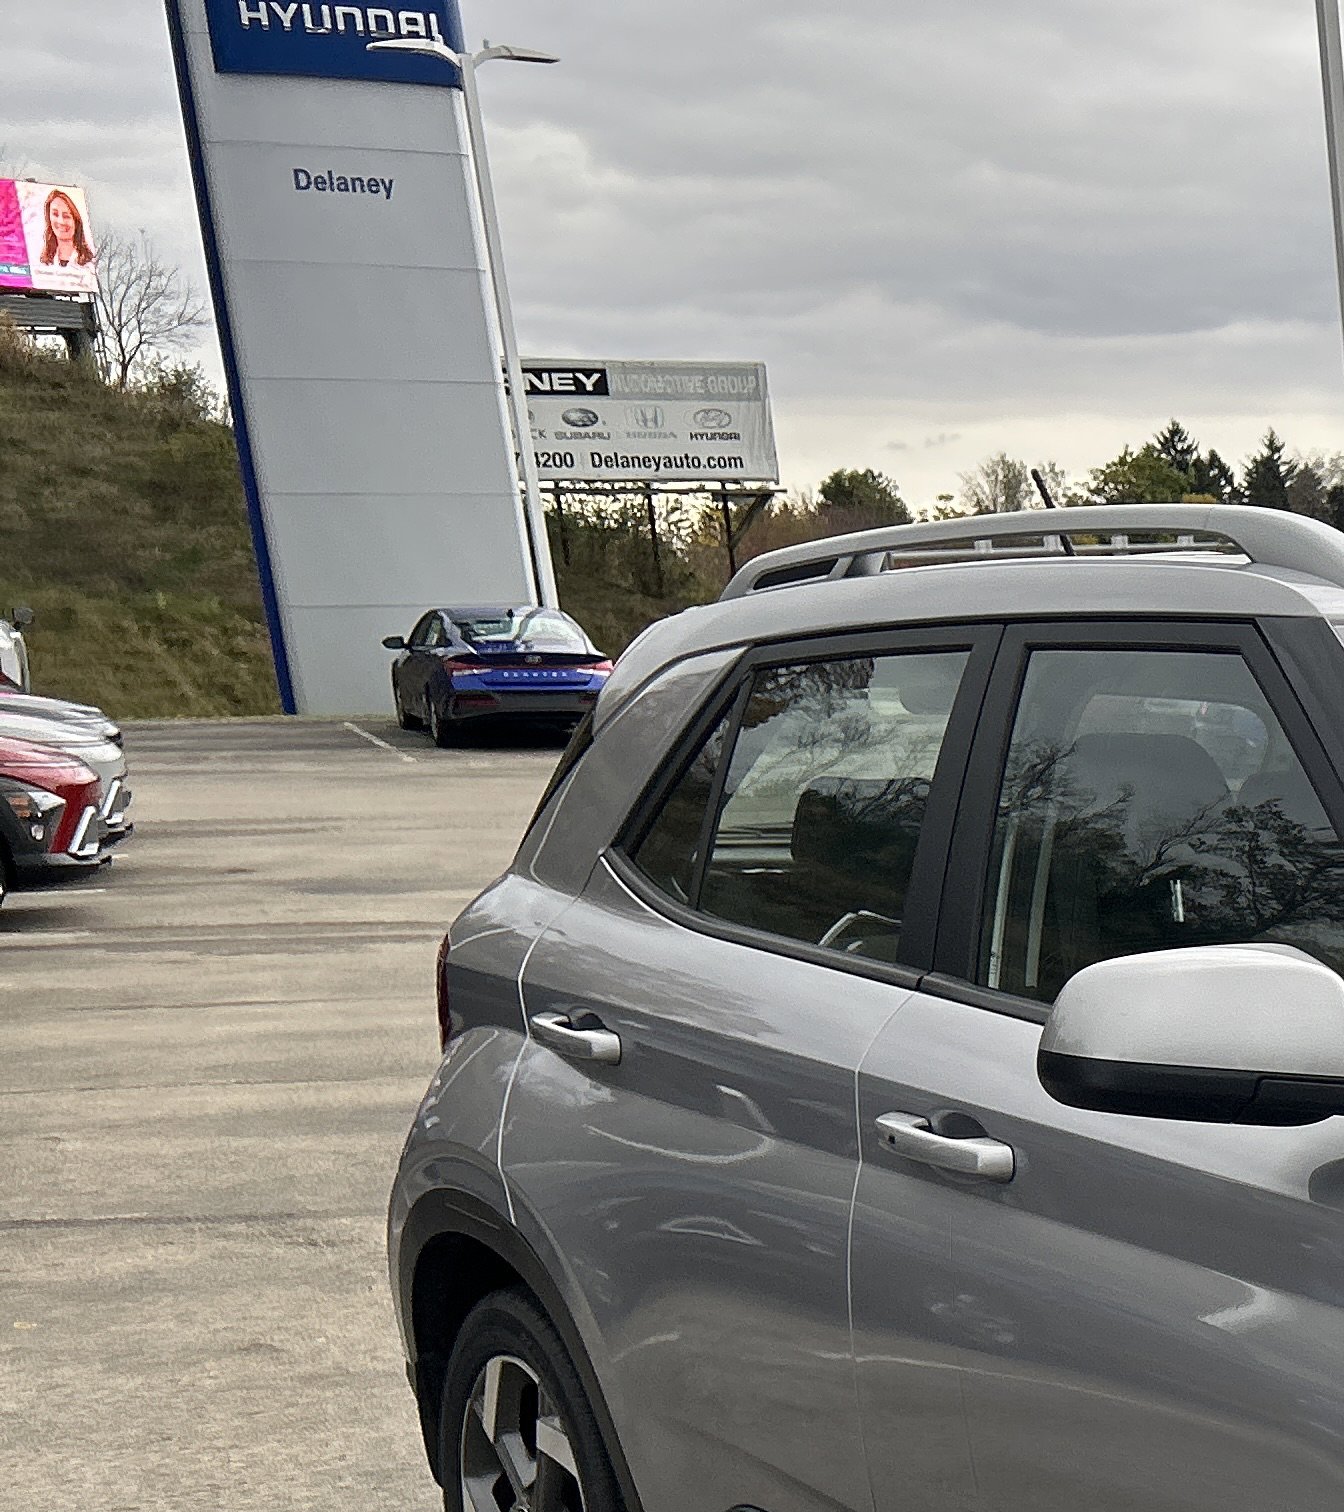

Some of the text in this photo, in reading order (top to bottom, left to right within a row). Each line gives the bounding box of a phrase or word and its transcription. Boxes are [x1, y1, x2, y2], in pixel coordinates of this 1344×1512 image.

[238, 0, 441, 38] HYUNDAI
[292, 168, 395, 200] Delaney
[503, 372, 602, 391] NEY
[689, 431, 741, 441] HYUNDAI
[590, 451, 745, 473] Delaneyauto.com
